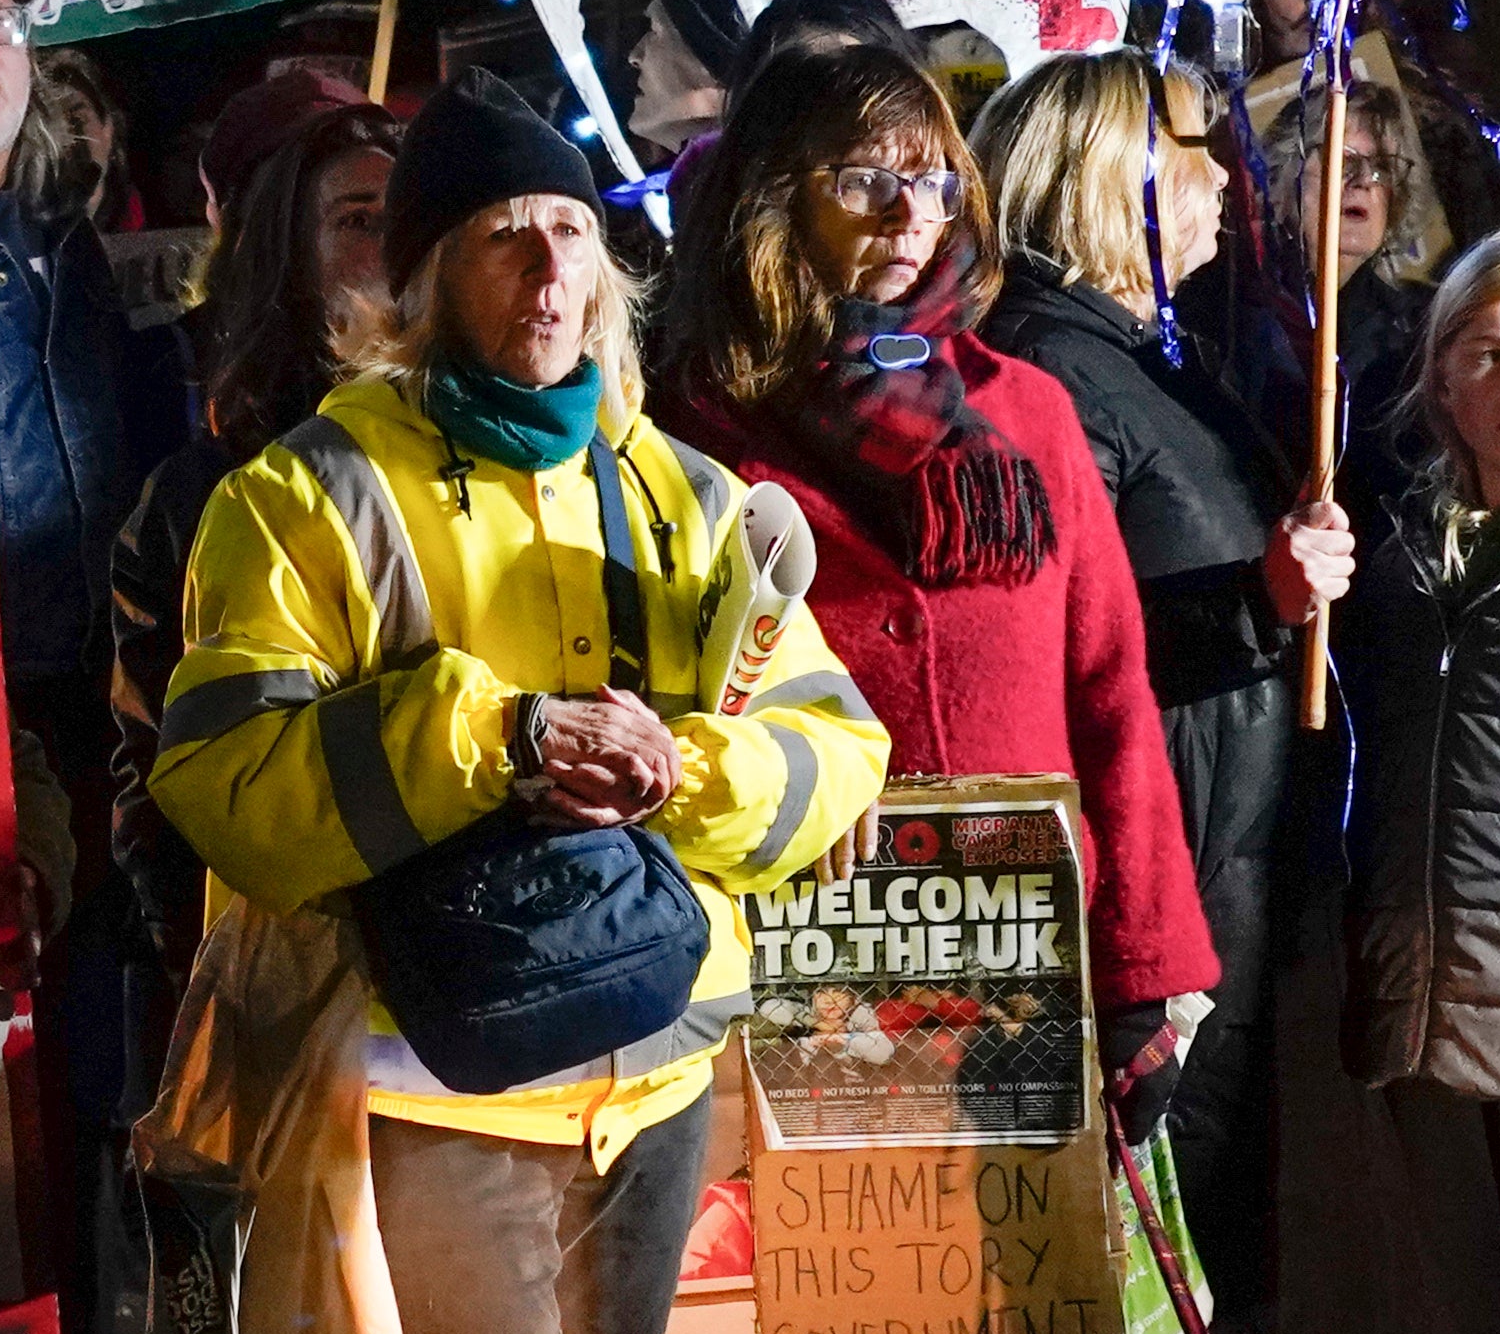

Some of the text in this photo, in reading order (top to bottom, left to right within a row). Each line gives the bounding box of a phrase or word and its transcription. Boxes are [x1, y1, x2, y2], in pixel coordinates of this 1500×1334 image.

[951, 815, 1062, 835] MIGRANTS
[756, 873, 1055, 928] WELCOME
[754, 922, 1064, 977] TO THE UK
[768, 1088, 810, 1098] NO BEDS
[822, 1085, 889, 1097] NO FRESH AIR
[901, 1085, 916, 1094] NO
[998, 1082, 1013, 1092] NO
[776, 1162, 1050, 1233] SHAME ON
[764, 1237, 1050, 1301] THIS TORY
